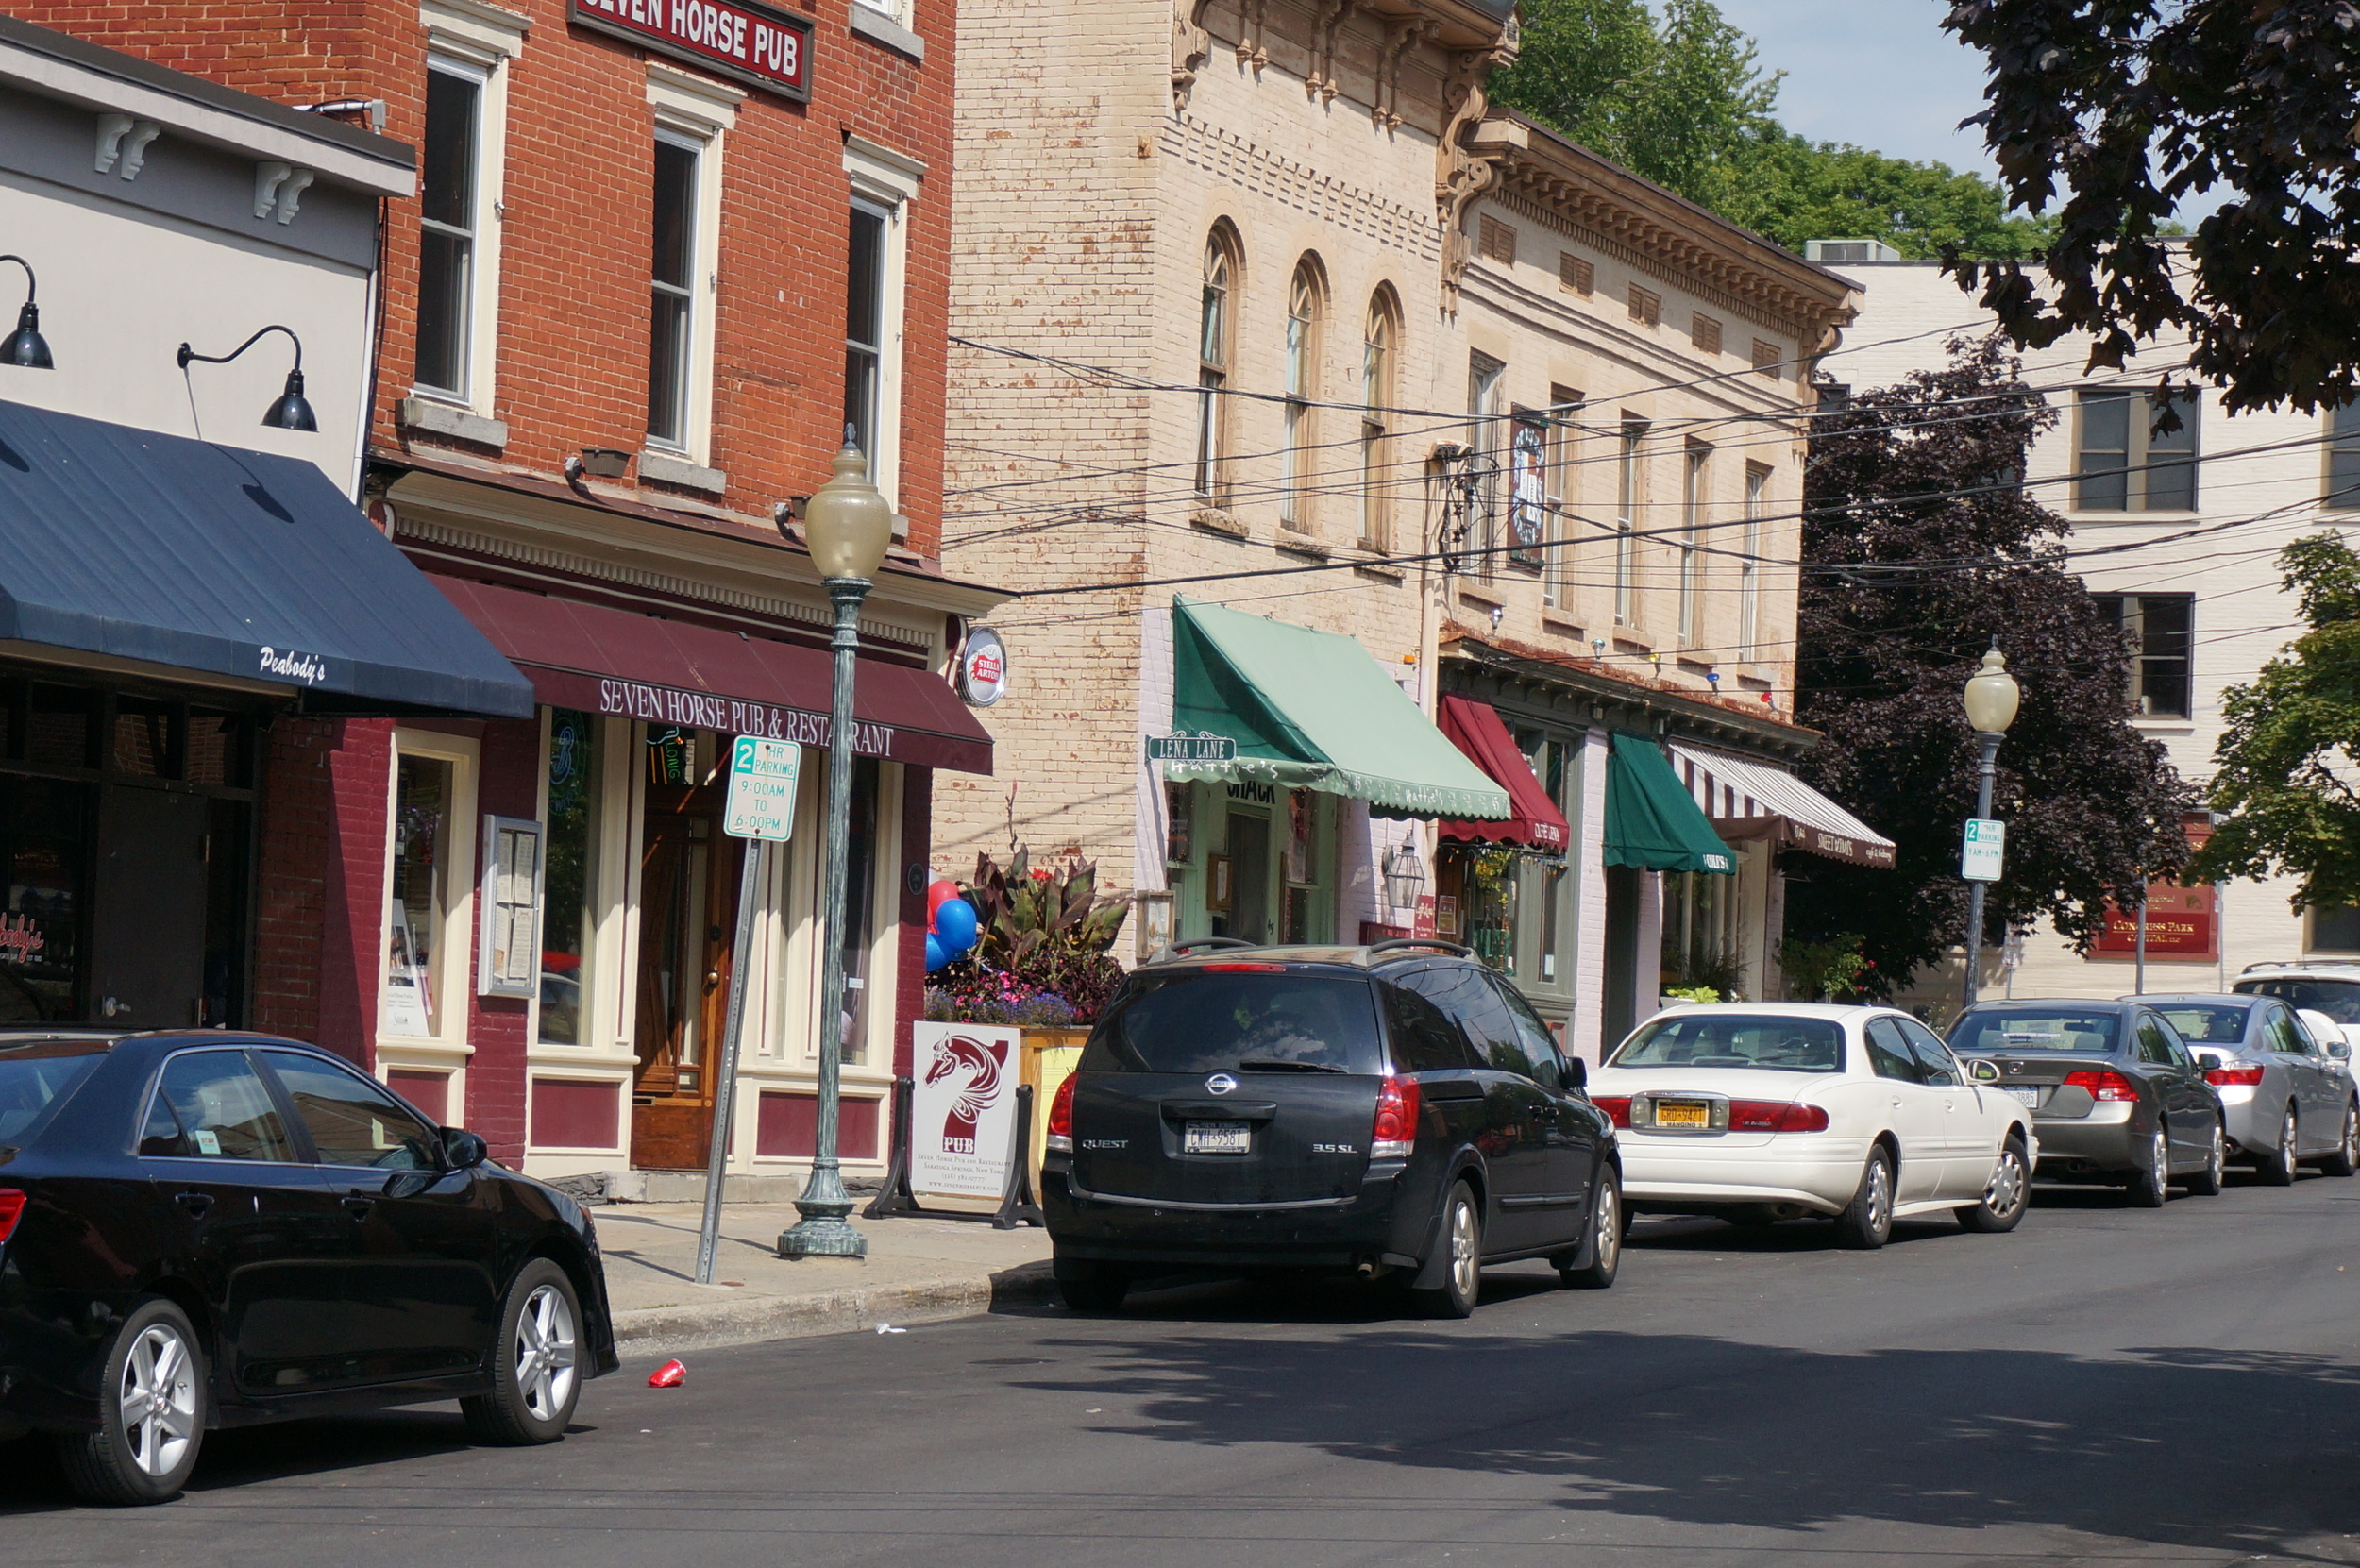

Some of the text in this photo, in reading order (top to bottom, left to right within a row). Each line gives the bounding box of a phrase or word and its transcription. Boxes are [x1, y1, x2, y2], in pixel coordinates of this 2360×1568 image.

[671, 0, 747, 60] HORSE
[754, 23, 797, 77] PUB
[260, 646, 326, 686] Peabody's
[978, 659, 1000, 671] STELLA
[976, 668, 1000, 680] ARTOIS
[600, 679, 894, 757] SEVEN HORSE PUB & RESTRANT
[737, 744, 784, 769] 2 HR
[1159, 739, 1225, 759] LENA LANE
[665, 741, 681, 779] LONG
[755, 759, 794, 776] PARKING
[1171, 757, 1278, 779] Hattie's
[1405, 785, 1444, 806] Hattie's
[754, 799, 767, 812] TO
[1968, 823, 1976, 839] 2
[1978, 833, 2000, 841] PARKING
[2113, 919, 2195, 933] CONRESS PARK
[944, 1136, 974, 1154] PUB
[1082, 1139, 1129, 1150] QUEST
[1217, 1129, 1241, 1146] 9581
[1338, 1144, 1357, 1154] SL
